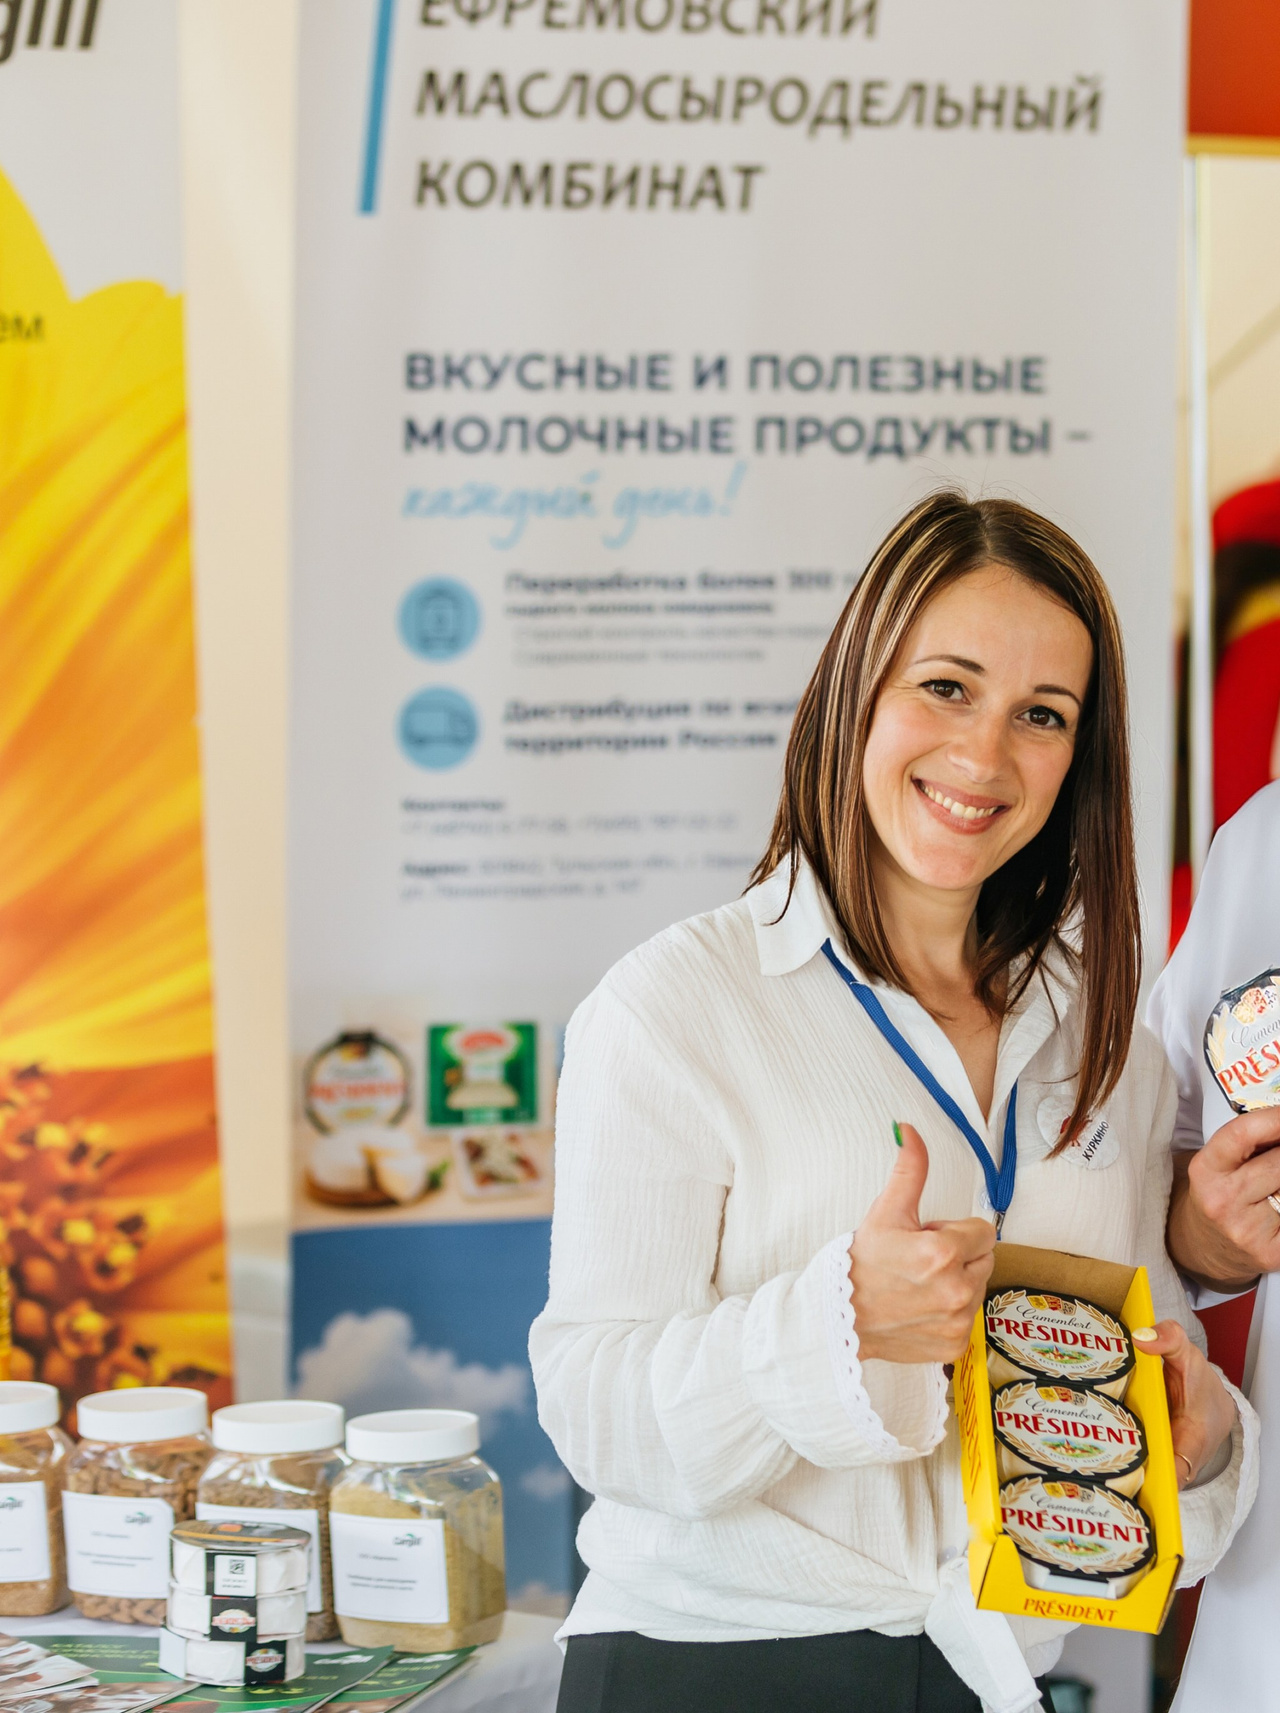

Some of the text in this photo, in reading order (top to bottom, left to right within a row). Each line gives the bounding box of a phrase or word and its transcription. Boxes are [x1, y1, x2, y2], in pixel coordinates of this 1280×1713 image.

[414, 69, 1103, 138] МАСЛОСЫРОДЕЛЬНЫЙ
[413, 159, 764, 211] КОМБИНАТ
[404, 353, 1046, 395] ВКУСНЫЕ И ПОЛЕЗНЫЕ
[403, 415, 734, 455] МОЛОЧНЫЕ
[754, 416, 1052, 462] ПРОДУКТЫ
[1082, 1121, 1109, 1162] КУРКИНО
[987, 1316, 1127, 1353] PRÉSIDENT
[1016, 1304, 1092, 1330] Camembert
[960, 1343, 982, 1497] ÉSIDENT
[1025, 1397, 1103, 1421] Camembert
[996, 1411, 1139, 1445] PRÉSIDENT
[1030, 1493, 1111, 1518] Camembert
[1001, 1507, 1147, 1544] PRÉSIDENT
[1023, 1598, 1118, 1622] PRÉSIDENT
